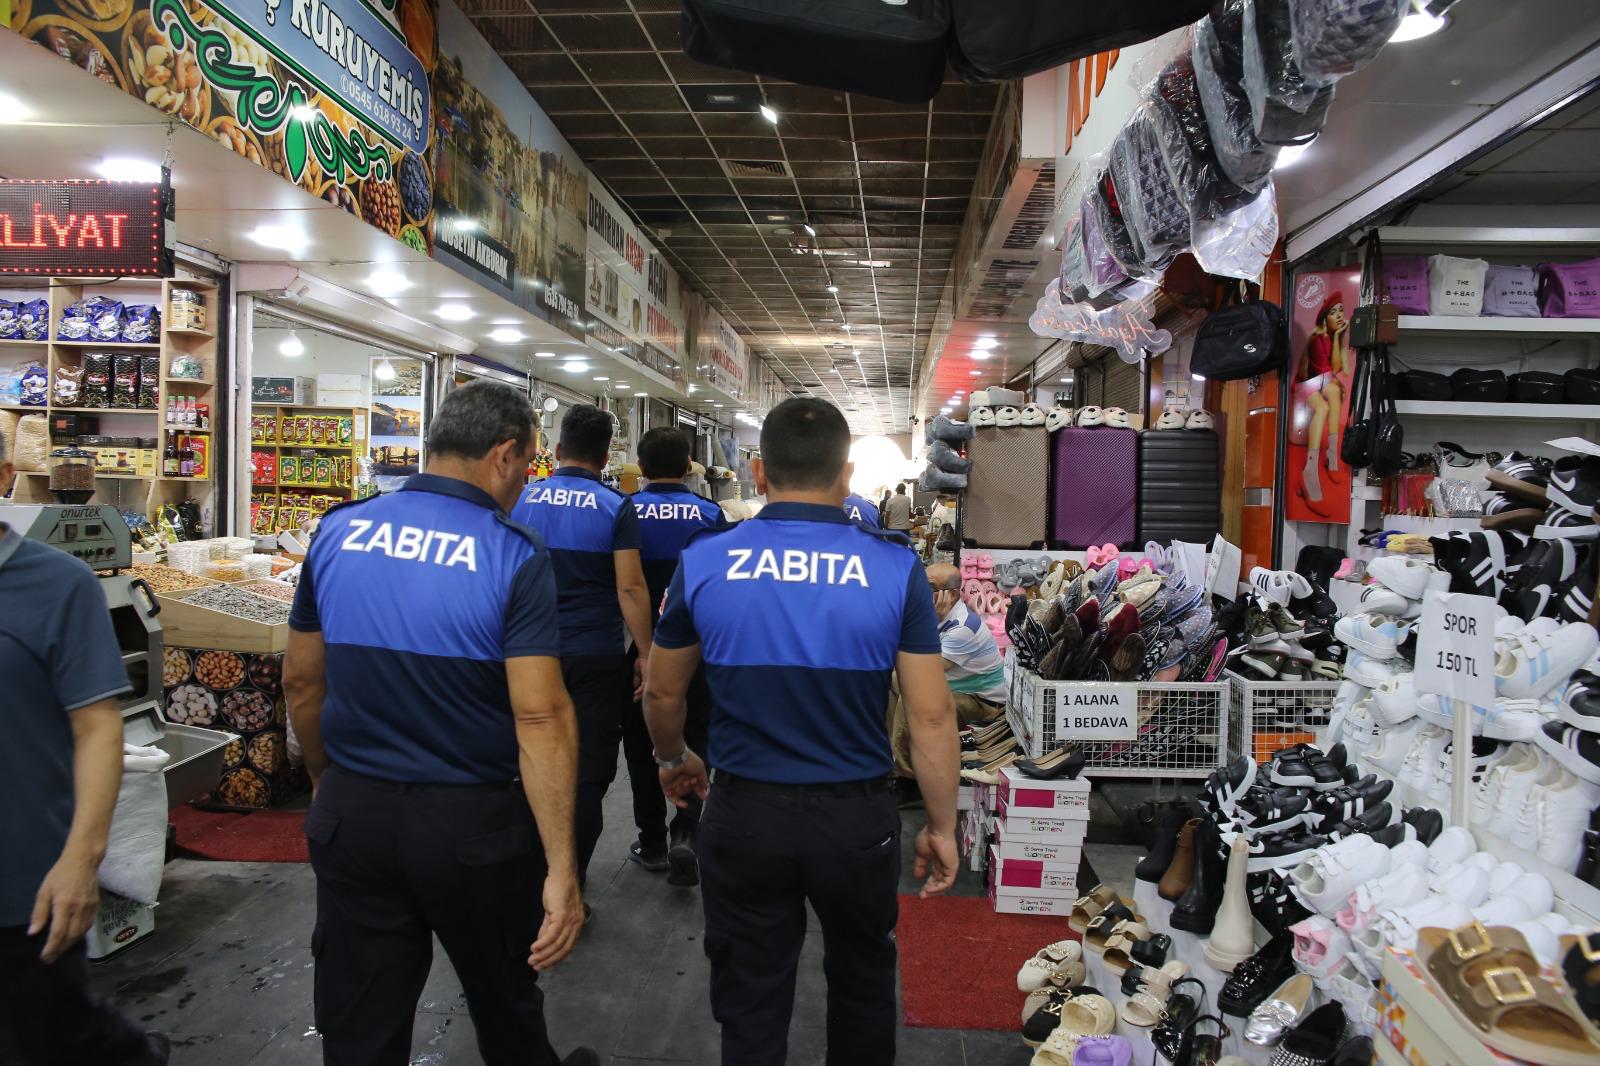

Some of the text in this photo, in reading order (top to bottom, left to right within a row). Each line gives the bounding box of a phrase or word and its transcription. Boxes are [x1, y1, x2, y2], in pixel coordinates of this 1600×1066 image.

[289, 0, 424, 143] KURUYEMİŞ
[350, 81, 413, 143] 0545 618 93 24
[588, 191, 625, 259] DEMİRHAN
[476, 240, 509, 281] AKBURAK
[525, 487, 598, 510] ZABITA
[634, 503, 702, 521] ZABITA
[60, 507, 101, 519] onurtek
[341, 519, 478, 573] ZABITA
[726, 548, 869, 588] ZABITA
[1443, 612, 1477, 636] SPOR
[1436, 650, 1478, 678] 150 TL
[1063, 694, 1119, 706] 1 ALANA
[1063, 717, 1128, 728] 1 BEDAVA
